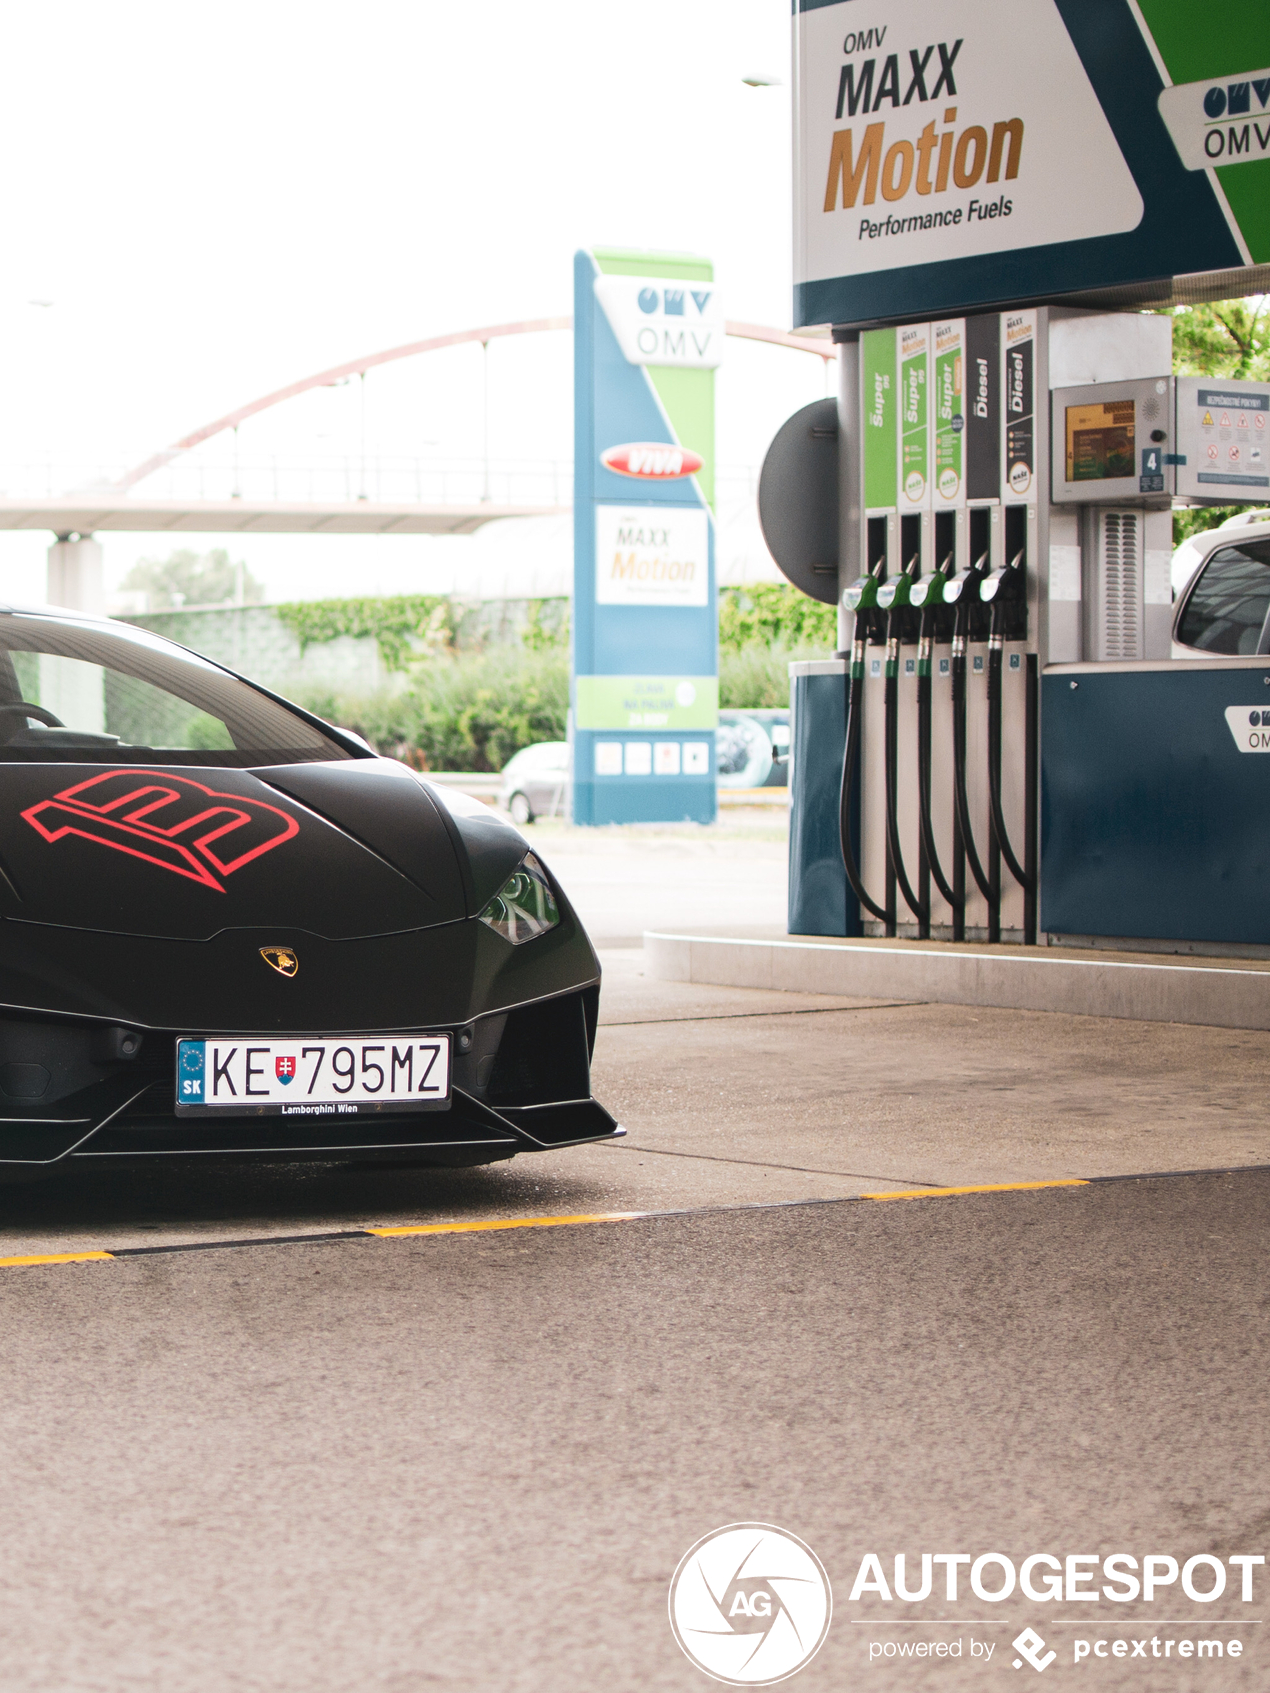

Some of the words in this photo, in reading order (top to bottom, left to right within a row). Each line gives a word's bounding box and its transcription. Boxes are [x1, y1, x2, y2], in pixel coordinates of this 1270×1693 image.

[843, 26, 887, 54] OMV
[835, 38, 964, 119] MAXX
[823, 106, 1025, 213] Motion
[858, 206, 963, 241] Performance
[966, 195, 1013, 223] Fuels
[637, 327, 712, 357] OMV
[873, 372, 885, 427] Super
[908, 367, 920, 423] Super
[941, 363, 954, 420] Super
[976, 358, 989, 418] Diesel
[1011, 352, 1024, 413] Diesel
[628, 449, 684, 475] VIVA
[1147, 453, 1157, 470] 4
[616, 527, 671, 547] MAXX
[610, 552, 696, 582] Motion
[183, 1079, 201, 1095] SK
[212, 1047, 271, 1096] KE
[301, 1044, 441, 1095] 795MZ
[282, 1104, 336, 1116] Lamborghini
[337, 1103, 358, 1114] Wien
